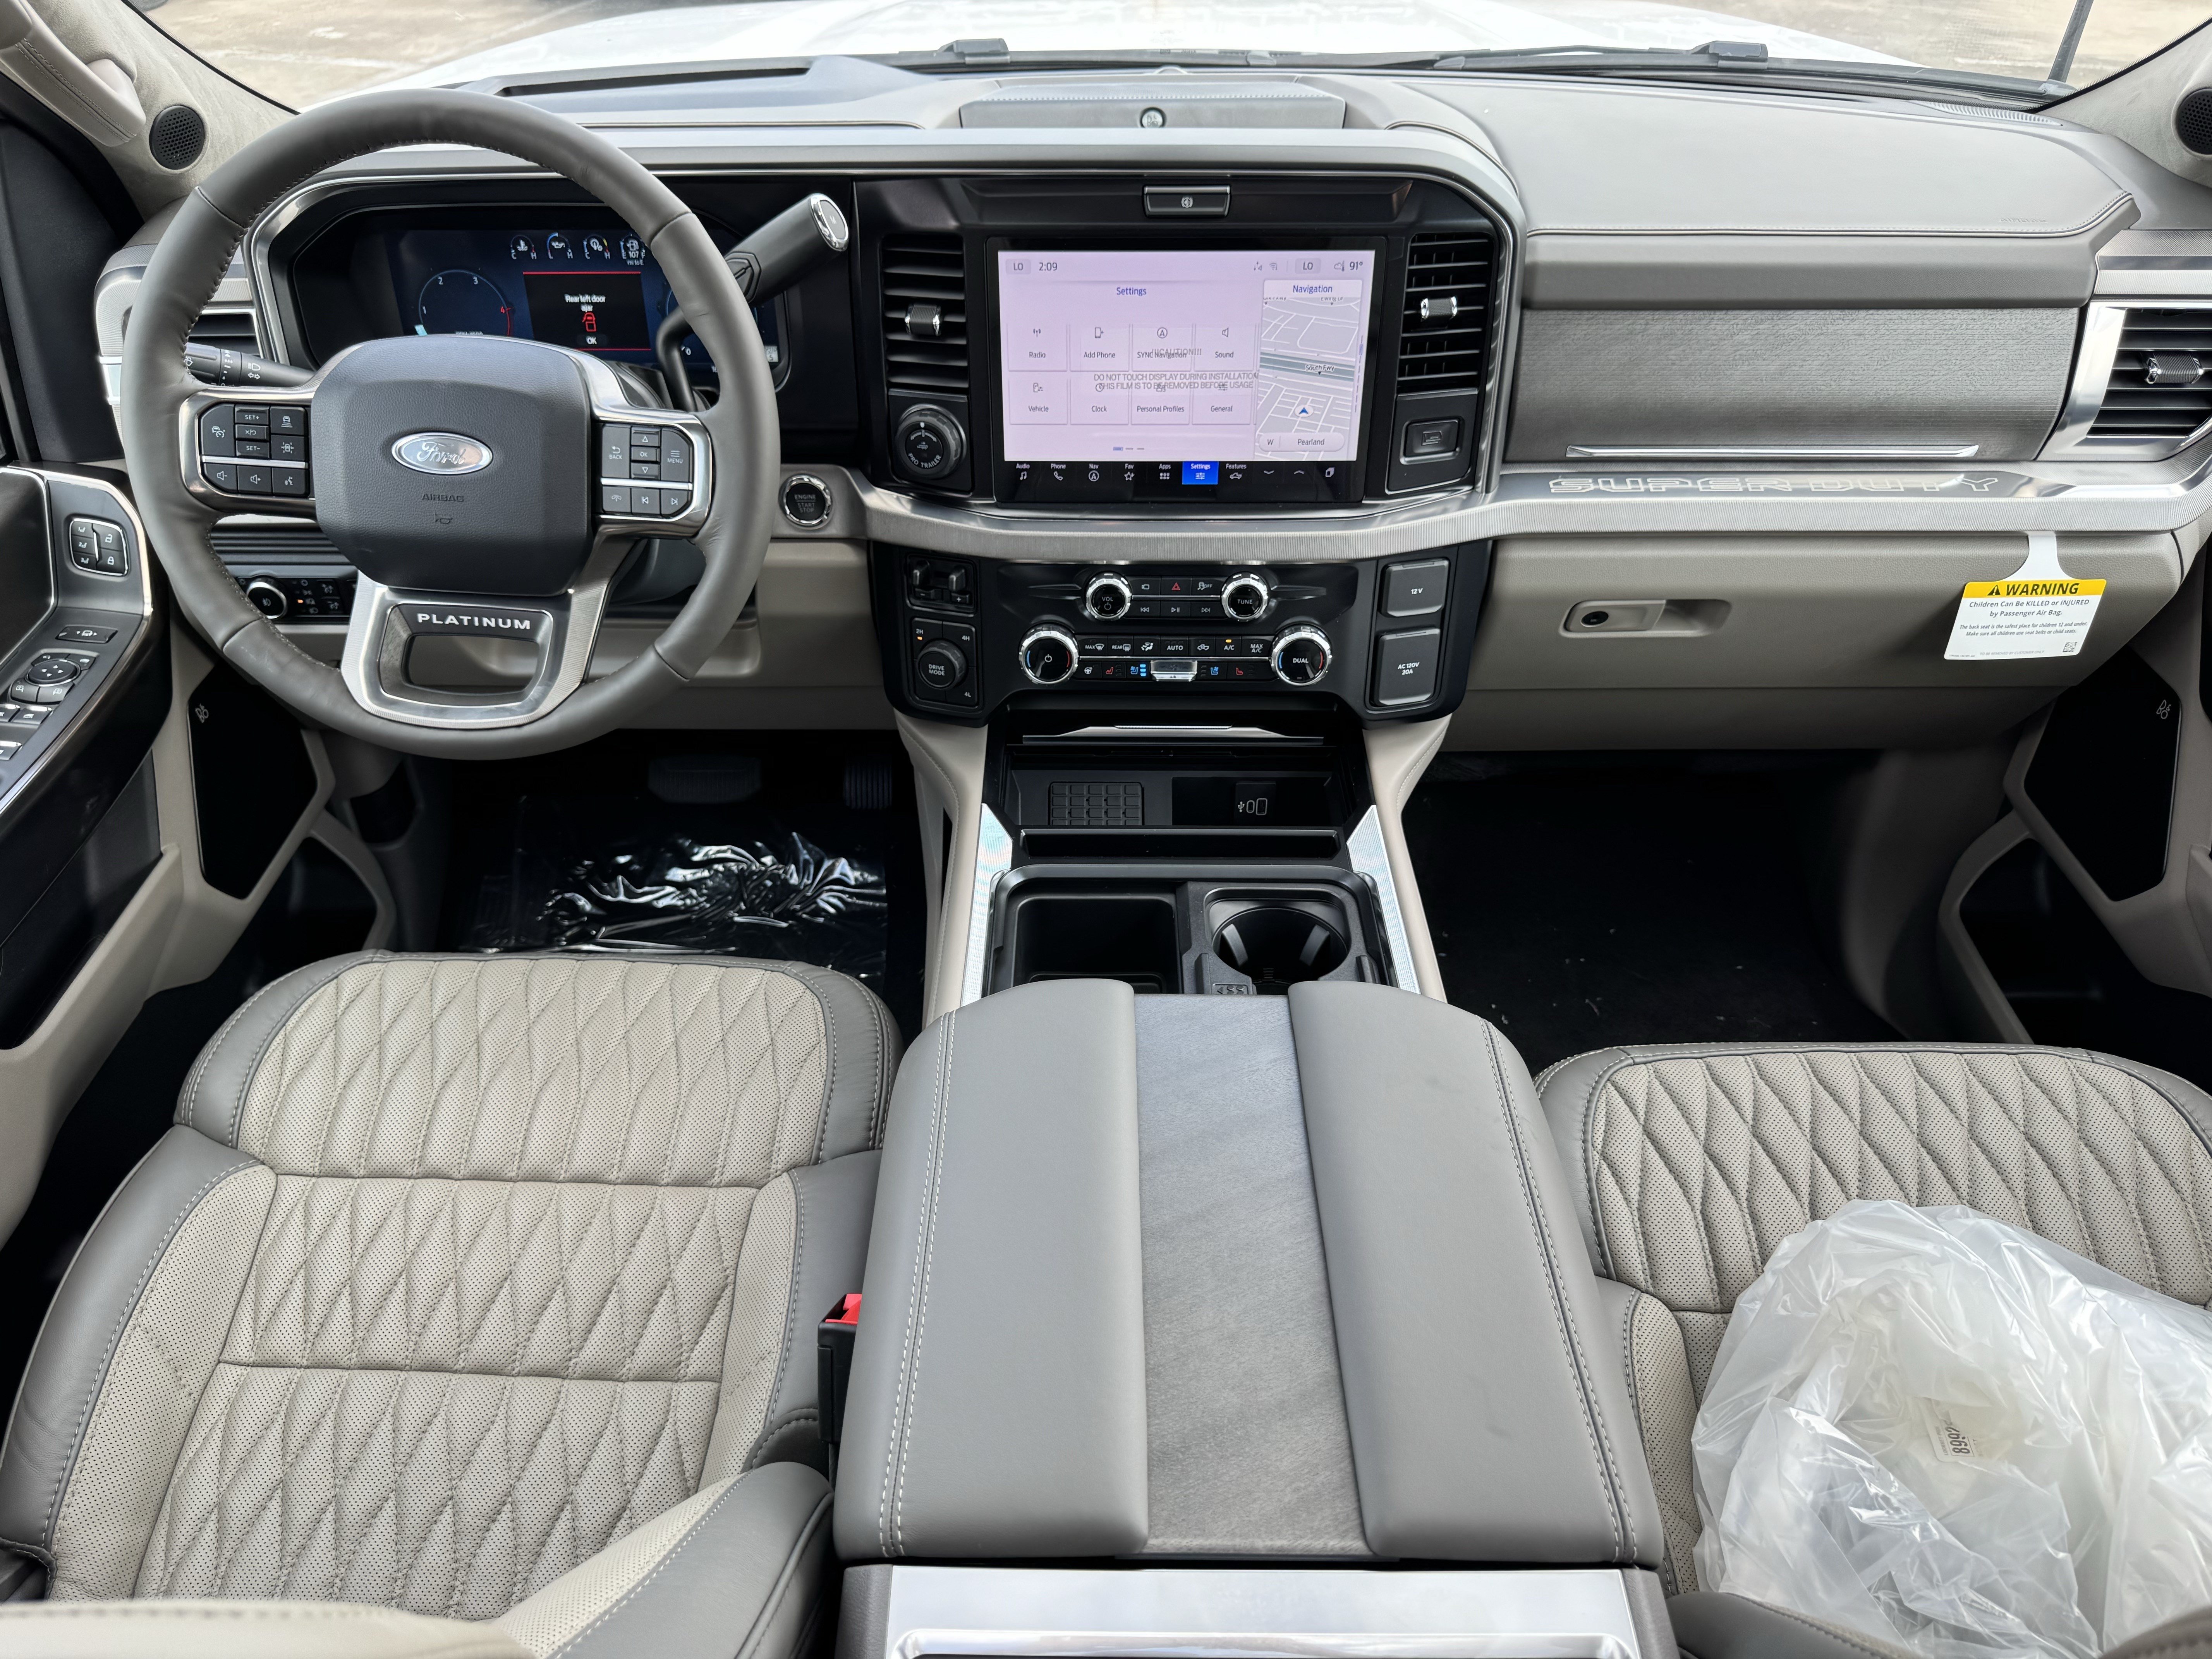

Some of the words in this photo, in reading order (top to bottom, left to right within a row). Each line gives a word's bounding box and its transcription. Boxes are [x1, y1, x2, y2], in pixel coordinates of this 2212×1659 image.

[1039, 262, 1058, 271] 2:09
[1303, 262, 1313, 270] LO
[438, 277, 443, 285] 2
[473, 276, 478, 285] 3
[1116, 287, 1147, 296] Settings
[1293, 285, 1333, 294] Navigation
[565, 294, 579, 302] Rear
[579, 294, 591, 302] left
[591, 294, 606, 302] door
[586, 336, 597, 344] OK
[417, 441, 466, 464] Ford
[908, 453, 919, 465] PRO
[921, 454, 941, 469] TRAILER
[1549, 477, 1792, 493] SUPER
[1808, 477, 1998, 491] DUTY
[422, 493, 464, 502] AIRBAG
[2006, 583, 2080, 596] WARNING
[417, 613, 531, 630] PLATINUM
